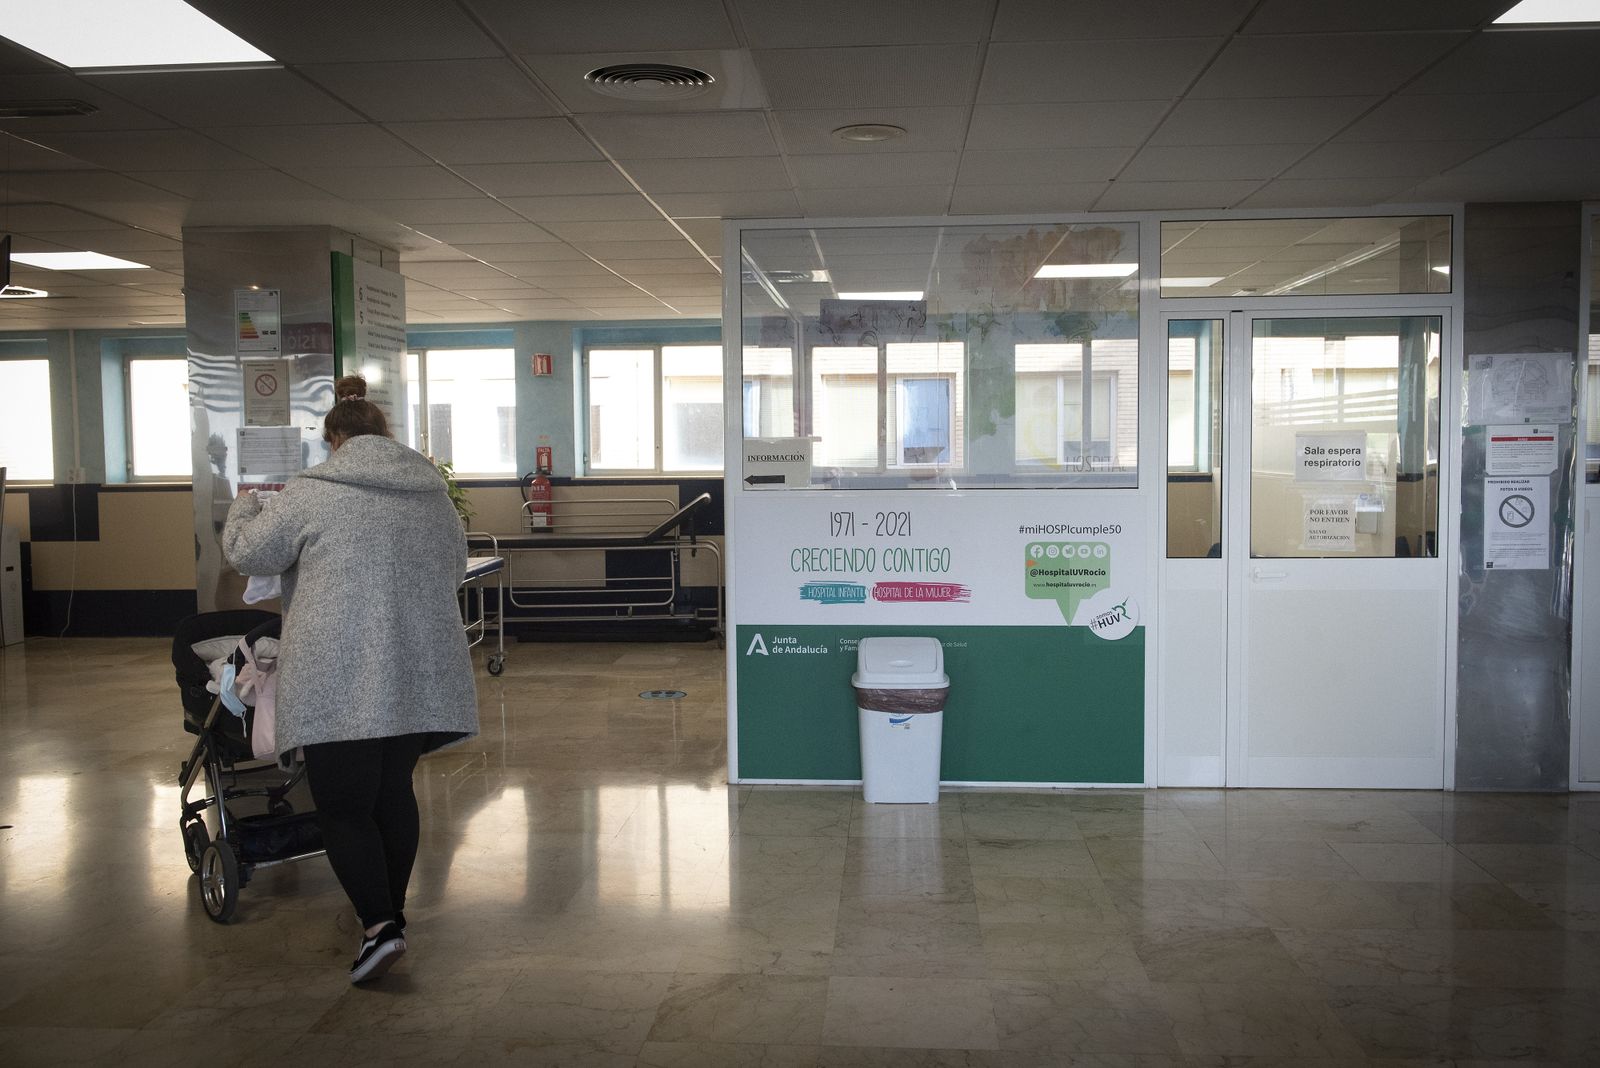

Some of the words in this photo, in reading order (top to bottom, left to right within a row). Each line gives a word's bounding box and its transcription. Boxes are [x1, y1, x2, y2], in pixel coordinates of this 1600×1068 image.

[747, 450, 805, 462] INFORMACIÓN
[1304, 446, 1325, 455] Sala
[1328, 448, 1361, 456] espera
[1304, 459, 1361, 468] respiratorio
[830, 511, 855, 538] 1971
[875, 511, 911, 537] 2021
[1019, 524, 1122, 536] #miHOSPIcumple50
[790, 547, 876, 573] CRECIENDO
[883, 547, 951, 573] CONTIGO
[1030, 568, 1106, 578] @HospitalUVRocio
[808, 586, 836, 599] HOSPITAL
[838, 586, 865, 599] INFANTIL
[874, 586, 902, 598] HOSPITAL
[904, 586, 914, 598] DE
[915, 586, 923, 598] LA
[925, 586, 951, 598] MUJER
[772, 636, 797, 644] Junta
[772, 646, 783, 654] de
[785, 644, 828, 654] Andalucía
